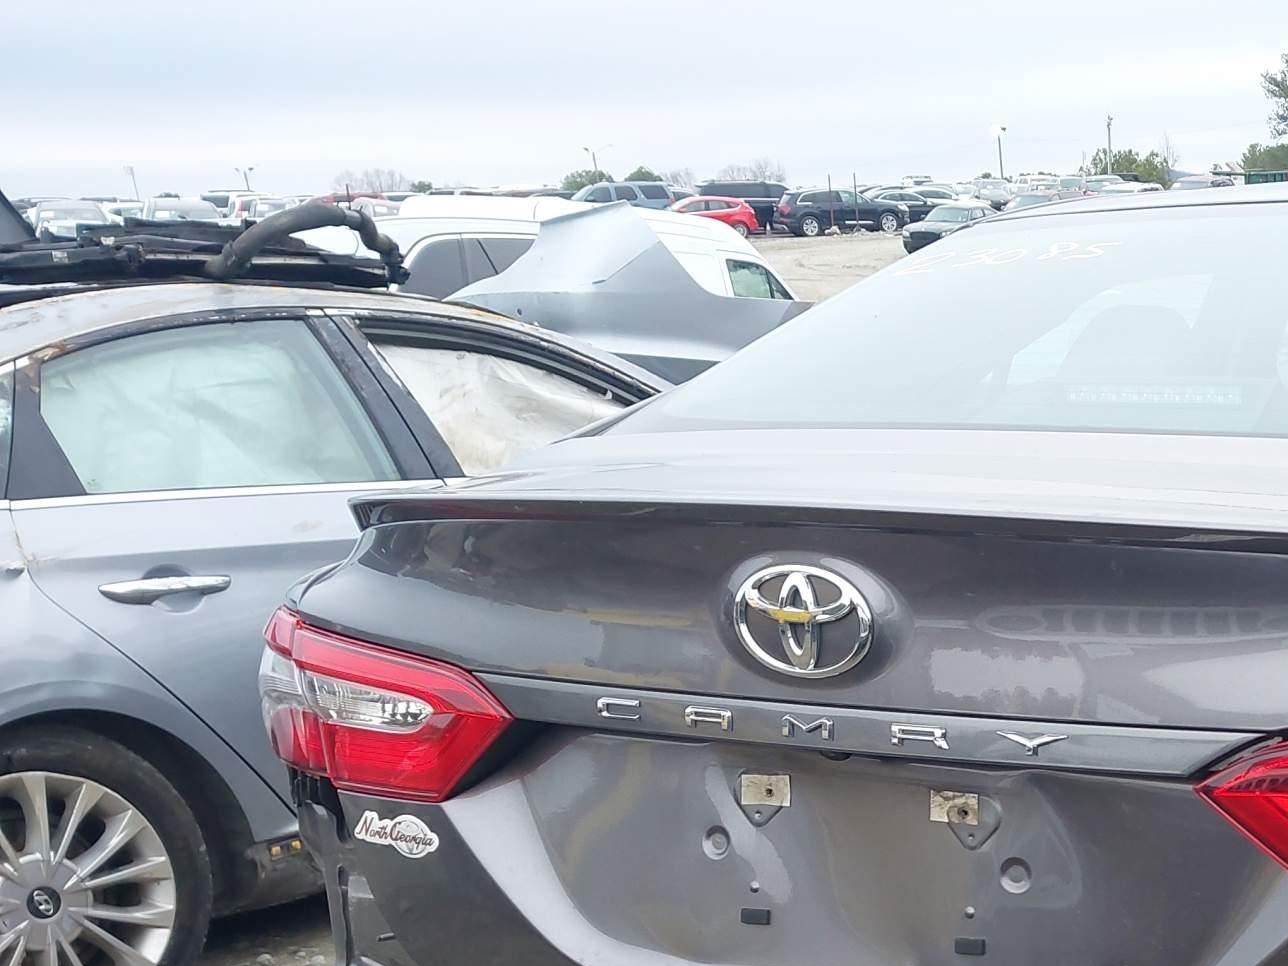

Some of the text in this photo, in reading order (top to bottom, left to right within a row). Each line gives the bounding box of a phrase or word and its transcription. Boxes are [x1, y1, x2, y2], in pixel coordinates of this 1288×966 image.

[596, 696, 1069, 757] CAMRY
[356, 815, 434, 850] North Georgia
